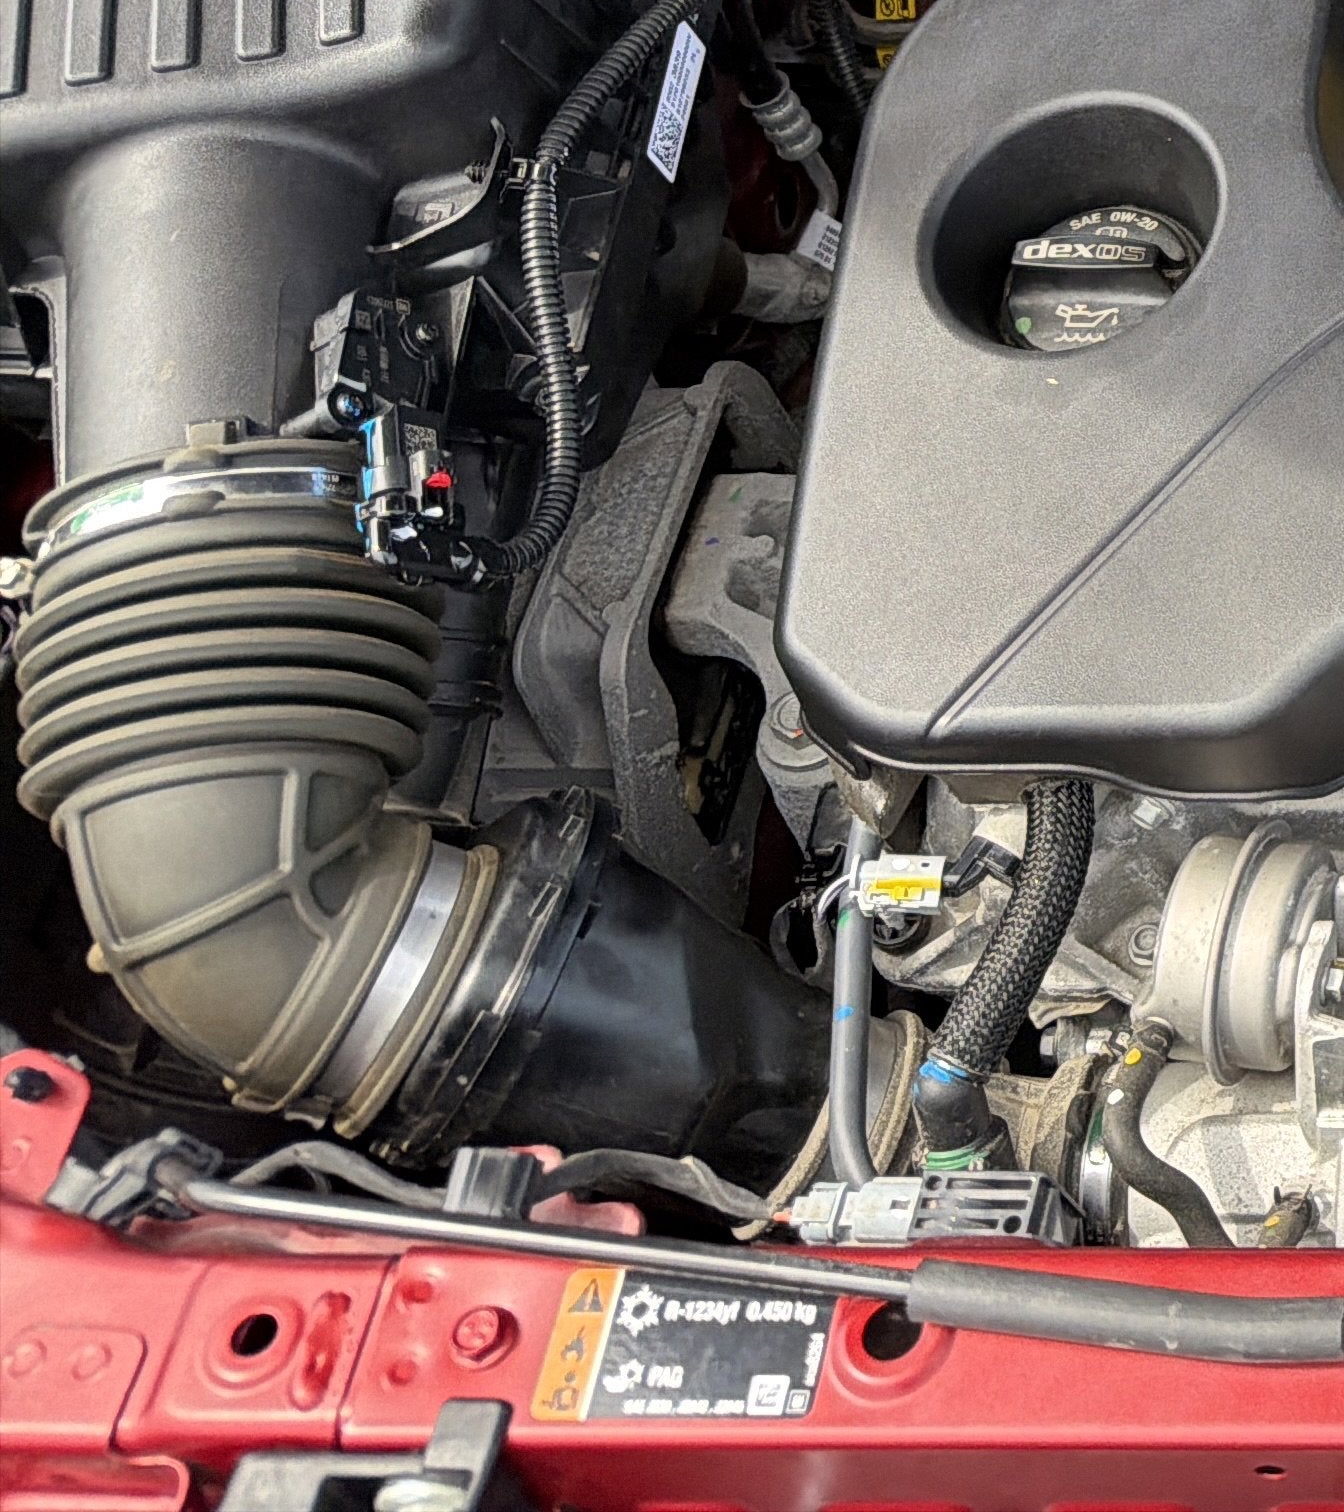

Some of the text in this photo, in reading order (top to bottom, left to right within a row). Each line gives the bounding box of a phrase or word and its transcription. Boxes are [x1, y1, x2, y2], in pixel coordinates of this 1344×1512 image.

[1069, 211, 1160, 231] SAE 0W-20
[1023, 240, 1147, 262] dexos
[664, 1299, 817, 1326] R-1234yf 0.450 kg
[646, 1364, 684, 1389] PAG
